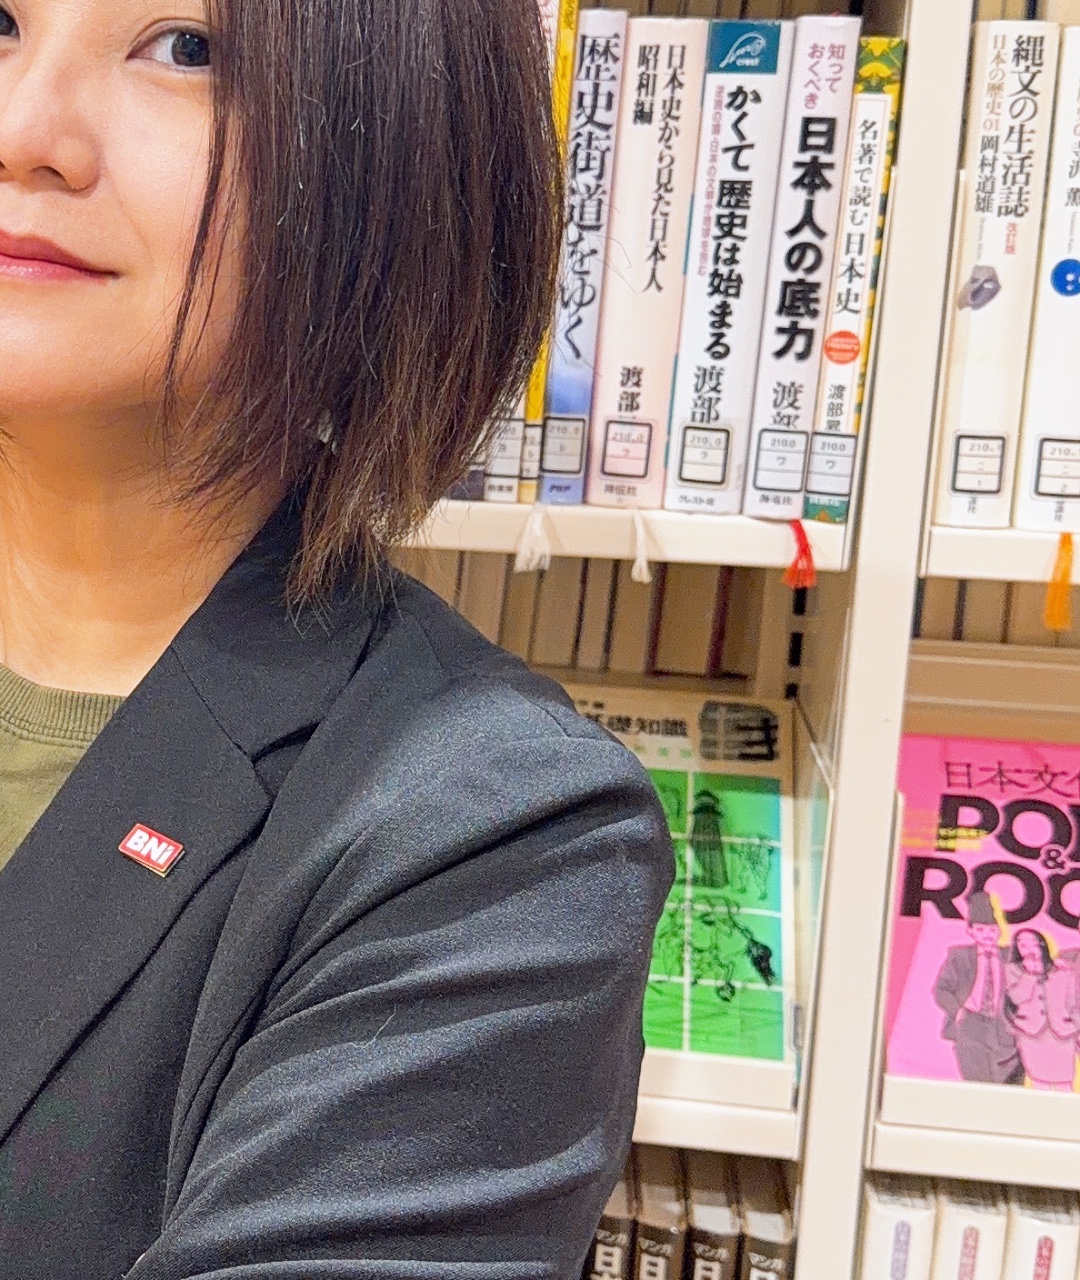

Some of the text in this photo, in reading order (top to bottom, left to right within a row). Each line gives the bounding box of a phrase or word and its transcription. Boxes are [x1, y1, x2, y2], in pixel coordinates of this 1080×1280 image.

[633, 43, 661, 126] 昭和編
[804, 44, 824, 110] おくべき
[825, 42, 846, 95] 知って
[997, 35, 1045, 218] 縄文の生活誌
[559, 33, 620, 360] 歴史街道をゆく
[642, 44, 687, 293] 日本史から見た日本人
[703, 85, 762, 361] かくて歴史は始まる
[835, 119, 878, 315] 名著で読む日本史
[975, 135, 1000, 213] 岡村道雄
[773, 117, 837, 363] 日本人の底力
[126, 829, 173, 864] BNI
[1040, 847, 1067, 870] &
